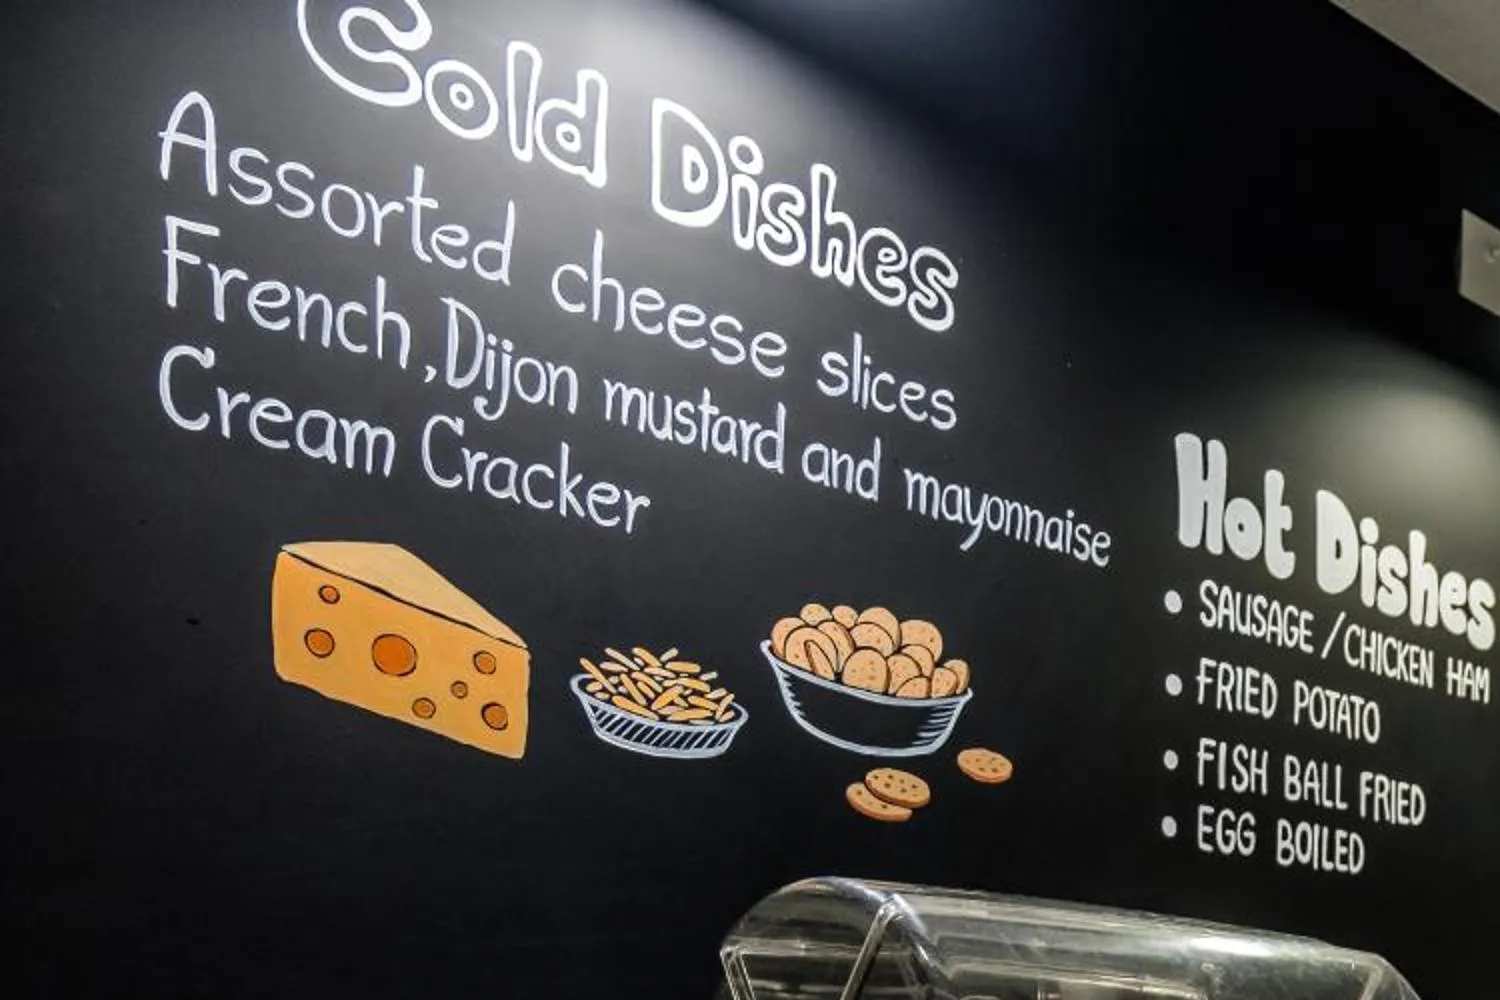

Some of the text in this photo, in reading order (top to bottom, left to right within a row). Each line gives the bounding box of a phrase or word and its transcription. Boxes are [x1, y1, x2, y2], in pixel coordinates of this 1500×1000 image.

[297, 0, 959, 331] Cold Dishes
[158, 91, 958, 430] Assorted cheese slices
[158, 345, 650, 534] Cream Cracker
[603, 378, 787, 474] mustard
[801, 437, 882, 502] and
[903, 466, 1112, 567] mayonnaise
[1174, 432, 1497, 651] Hot Dishes
[1196, 657, 1381, 744] FRIED POTATO
[1199, 579, 1315, 654] SAUSAGE
[1447, 656, 1491, 704] HAM
[1196, 737, 1426, 826] FISH BALL FRIED
[1197, 805, 1366, 875] EGG BOILED
